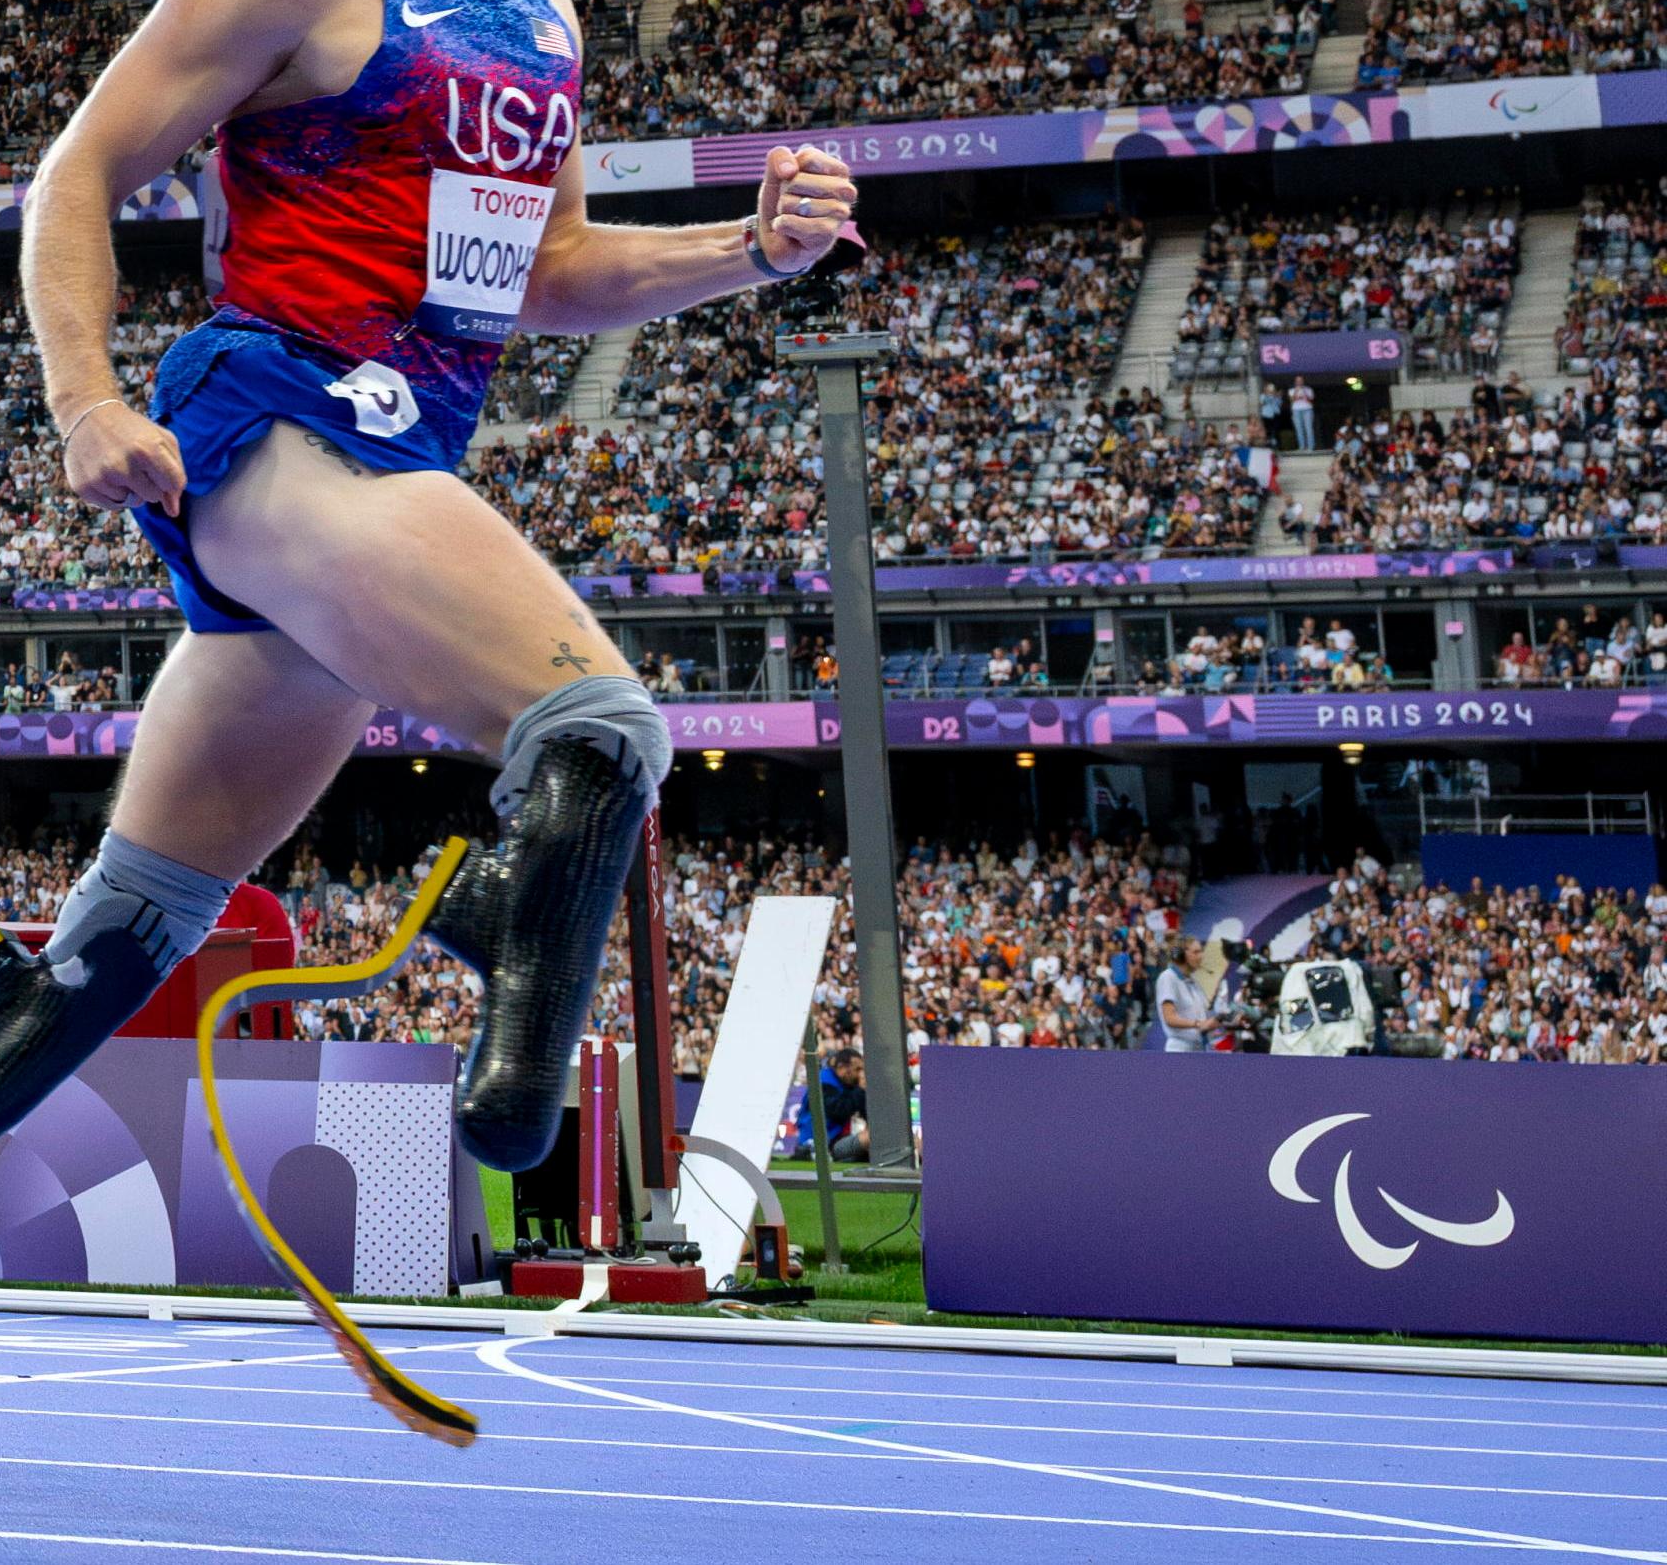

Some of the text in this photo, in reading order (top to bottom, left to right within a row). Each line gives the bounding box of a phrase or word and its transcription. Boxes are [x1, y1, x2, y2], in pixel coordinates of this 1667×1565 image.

[447, 77, 575, 172] USA
[800, 131, 997, 162] RIS 2024
[470, 187, 548, 221] TOYOTA
[435, 230, 536, 292] WOODH
[1261, 339, 1399, 365] E4 E3
[682, 715, 766, 737] 2024
[1317, 701, 1534, 728] PARIS 2024
[364, 724, 398, 747] D5
[820, 718, 841, 741] D
[922, 717, 961, 740] D2
[648, 812, 661, 921] MEGA
